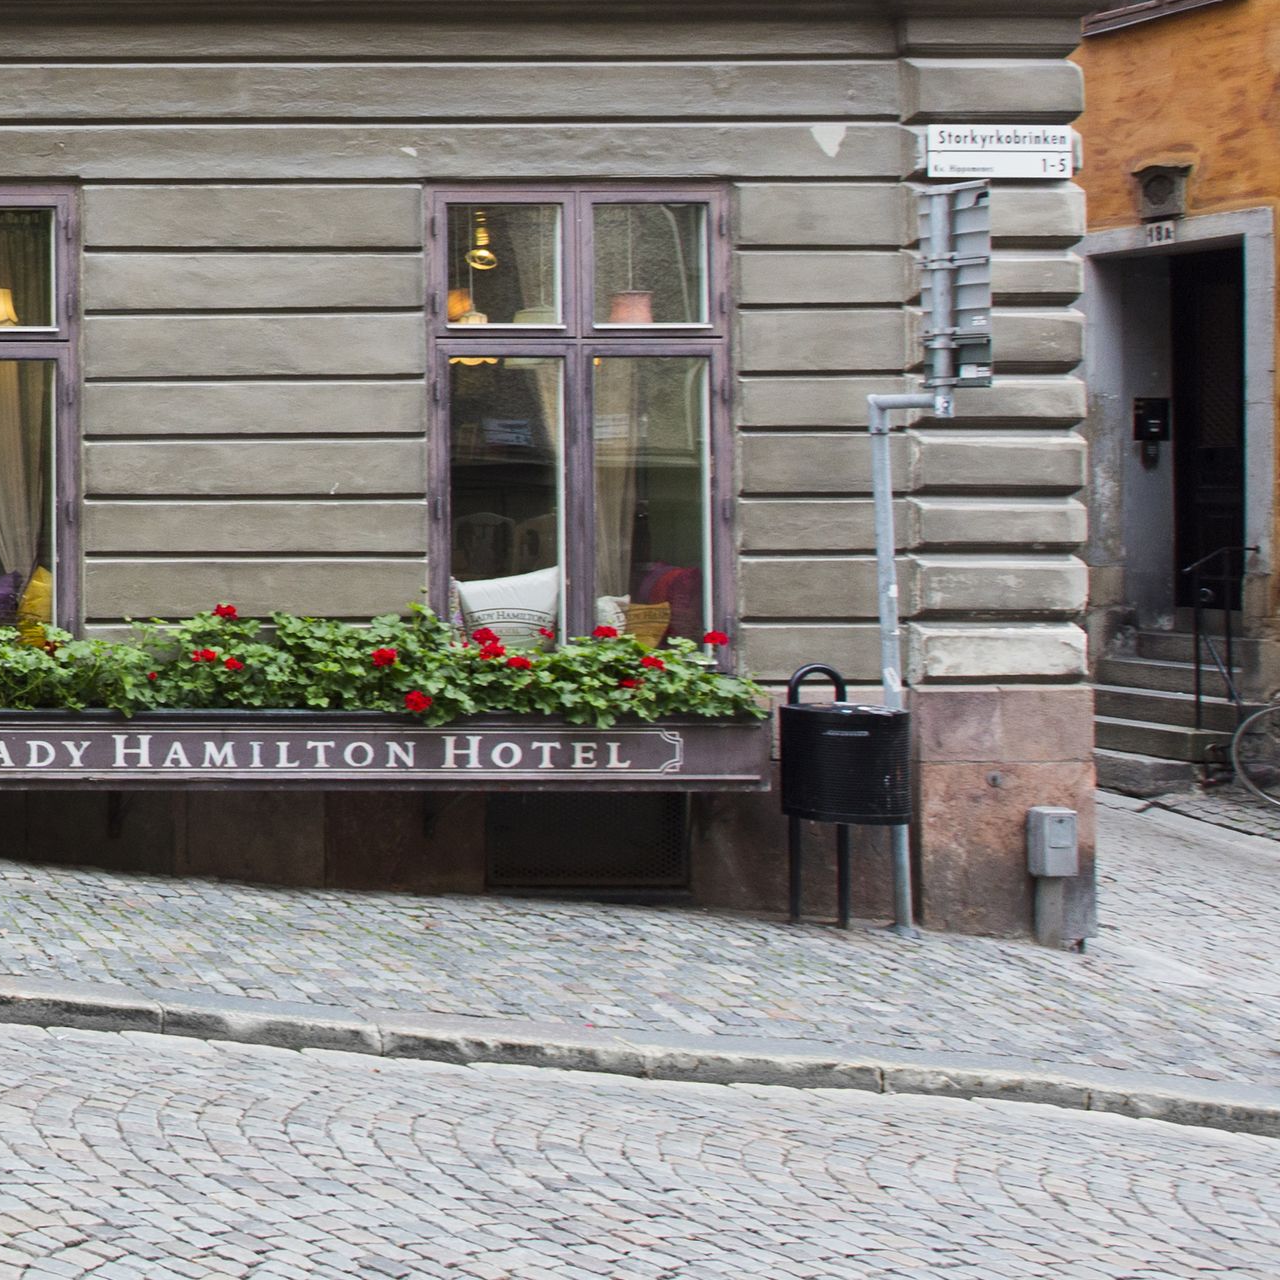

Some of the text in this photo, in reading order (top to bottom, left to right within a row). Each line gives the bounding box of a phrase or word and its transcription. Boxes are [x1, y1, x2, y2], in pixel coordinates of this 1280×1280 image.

[938, 129, 1067, 149] Storkyrkobrinken
[1042, 158, 1066, 172] 1-5
[496, 610, 547, 623] HAMILTON
[111, 734, 417, 768] HAMILTON
[441, 735, 631, 769] HOTEL
